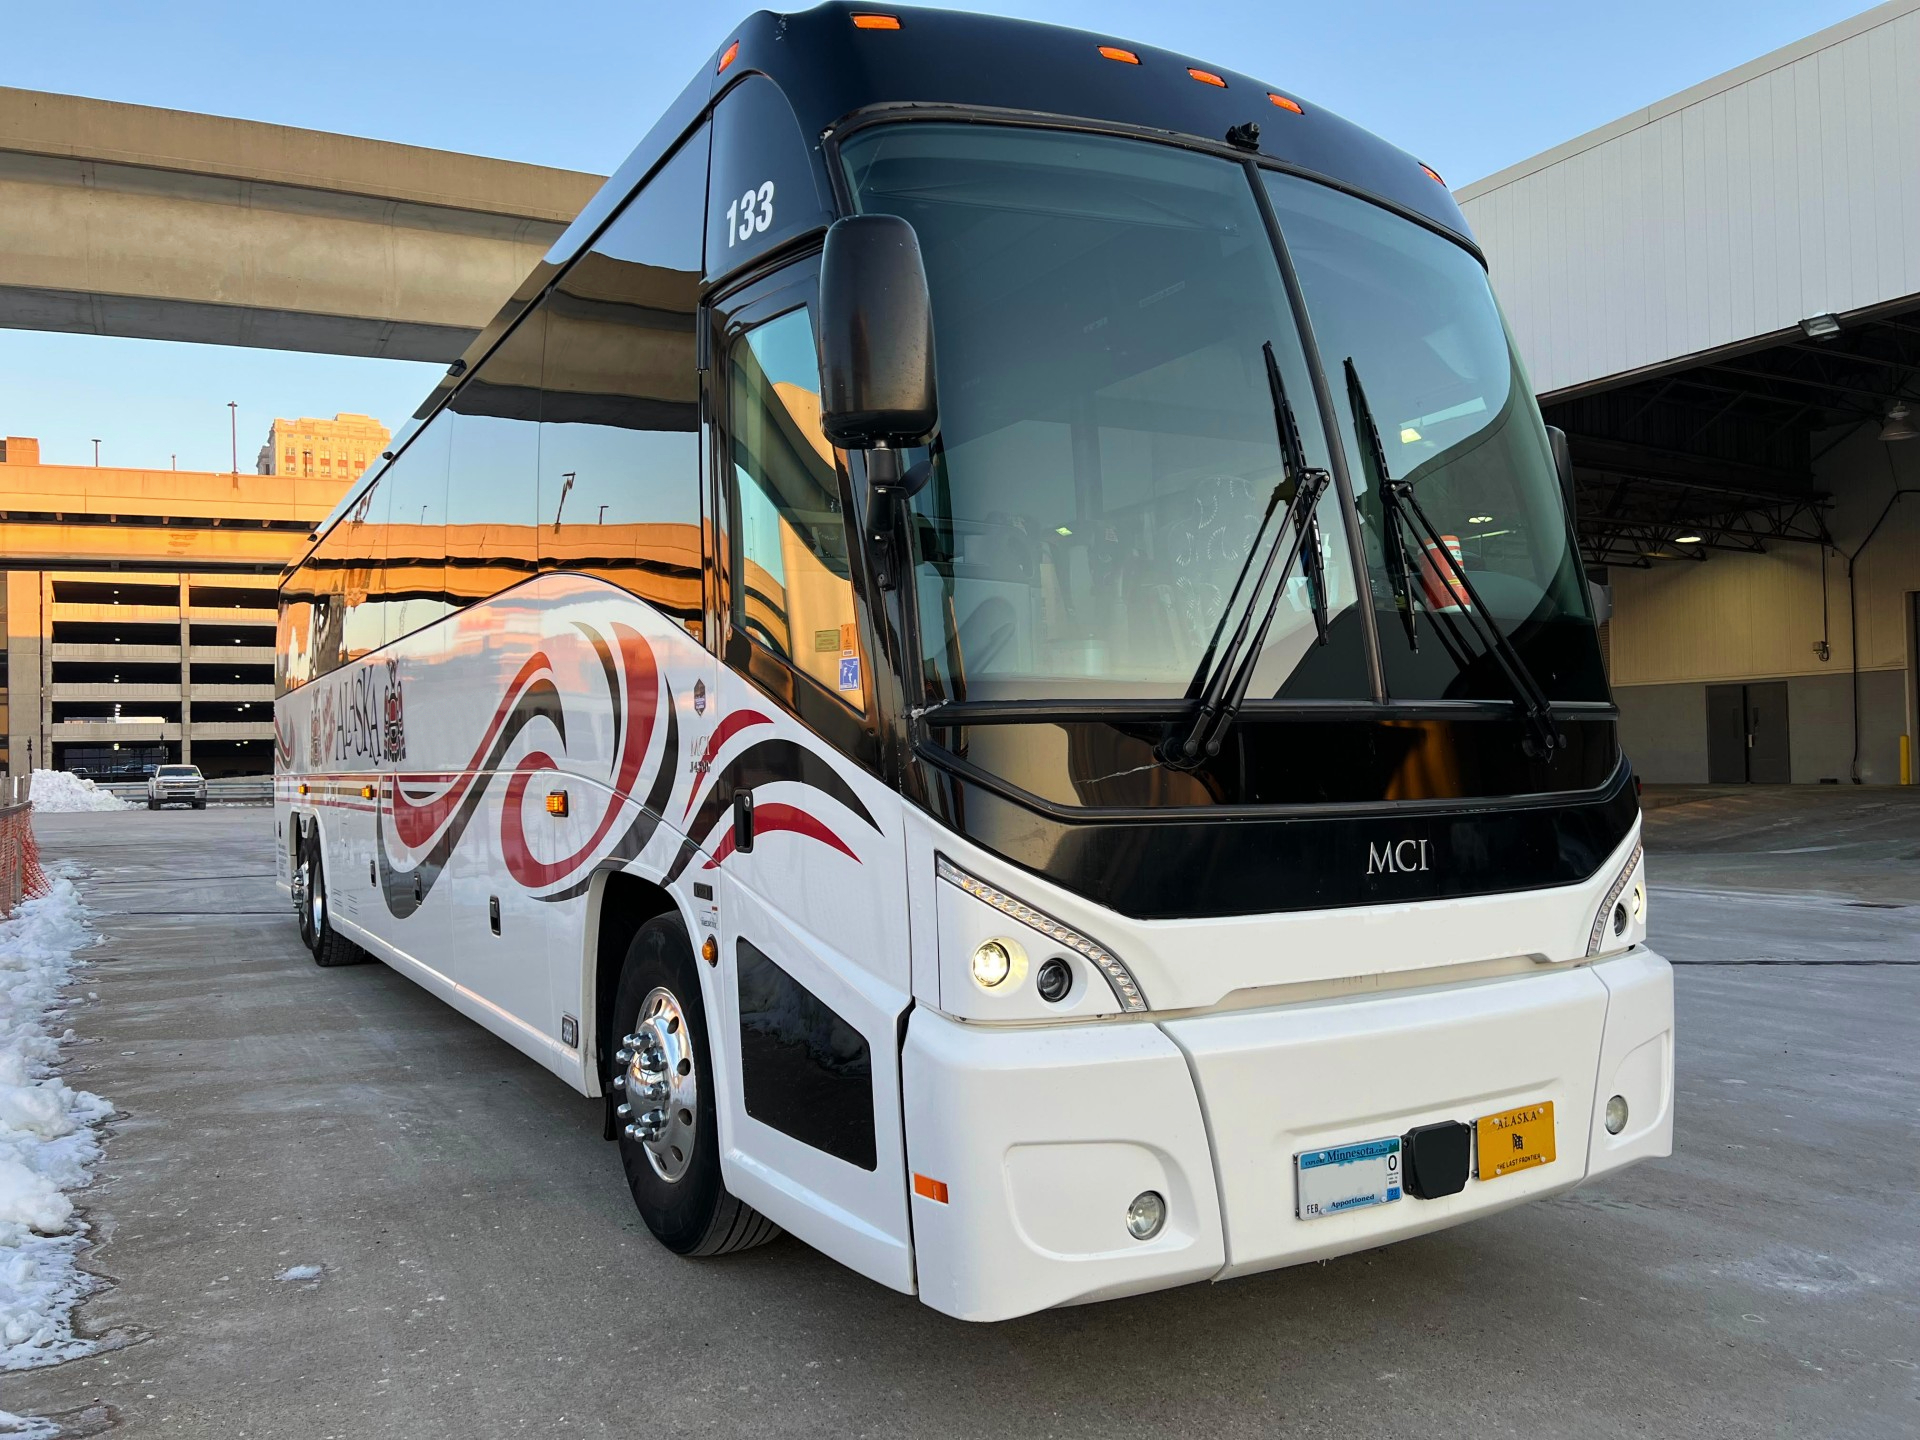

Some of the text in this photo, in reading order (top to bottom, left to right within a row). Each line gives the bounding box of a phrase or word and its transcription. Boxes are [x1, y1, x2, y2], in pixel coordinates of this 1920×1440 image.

[726, 180, 774, 248] 133
[336, 664, 381, 766] ALASKA
[690, 735, 710, 757] MCI
[1366, 839, 1430, 875] MCI
[1497, 1111, 1537, 1130] ALASKA
[1506, 1158, 1518, 1168] LAST
[1306, 1203, 1319, 1214] FEB
[1331, 1194, 1375, 1208] Apportioned
